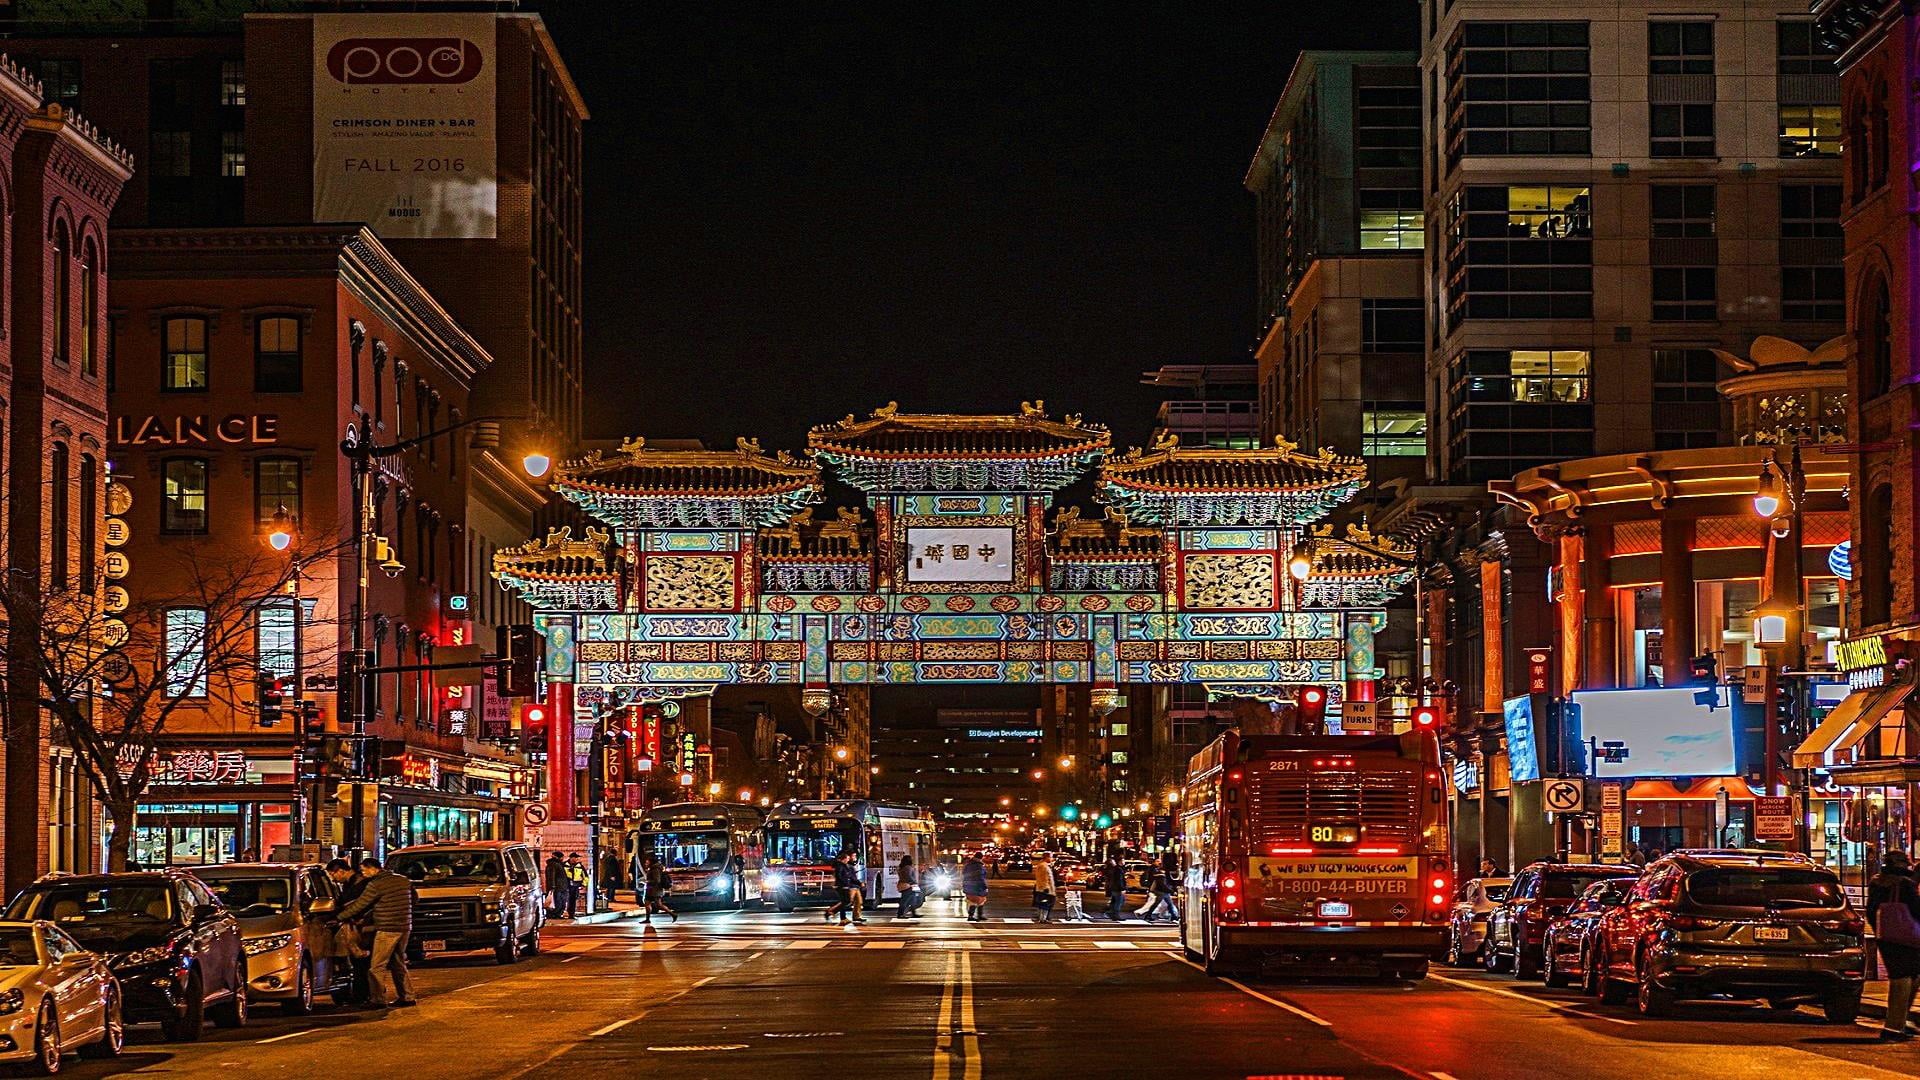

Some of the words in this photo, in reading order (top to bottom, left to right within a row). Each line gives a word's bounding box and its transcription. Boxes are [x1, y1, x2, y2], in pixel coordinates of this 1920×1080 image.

[343, 38, 465, 85] pod
[441, 53, 459, 61] DC
[333, 119, 391, 128] CRIMSON
[396, 119, 435, 128] DINER
[449, 119, 476, 128] BAR
[345, 159, 400, 172] FALL
[414, 158, 465, 172] 2016
[388, 208, 421, 218] MODUS
[107, 415, 279, 445] IANCE
[977, 729, 1000, 738] Douglas
[1001, 729, 1039, 738] Development
[170, 749, 246, 781] 藥房
[1270, 761, 1299, 770] 2871
[651, 821, 662, 830] X2
[779, 820, 790, 830] P6
[1311, 826, 1333, 842] 80
[1277, 865, 1294, 874] WE
[1297, 863, 1316, 874] BUY
[1319, 863, 1343, 875] UGLY
[1345, 863, 1408, 875] HOUSES.COM
[1277, 880, 1407, 893] 1-800-44-BUYER
